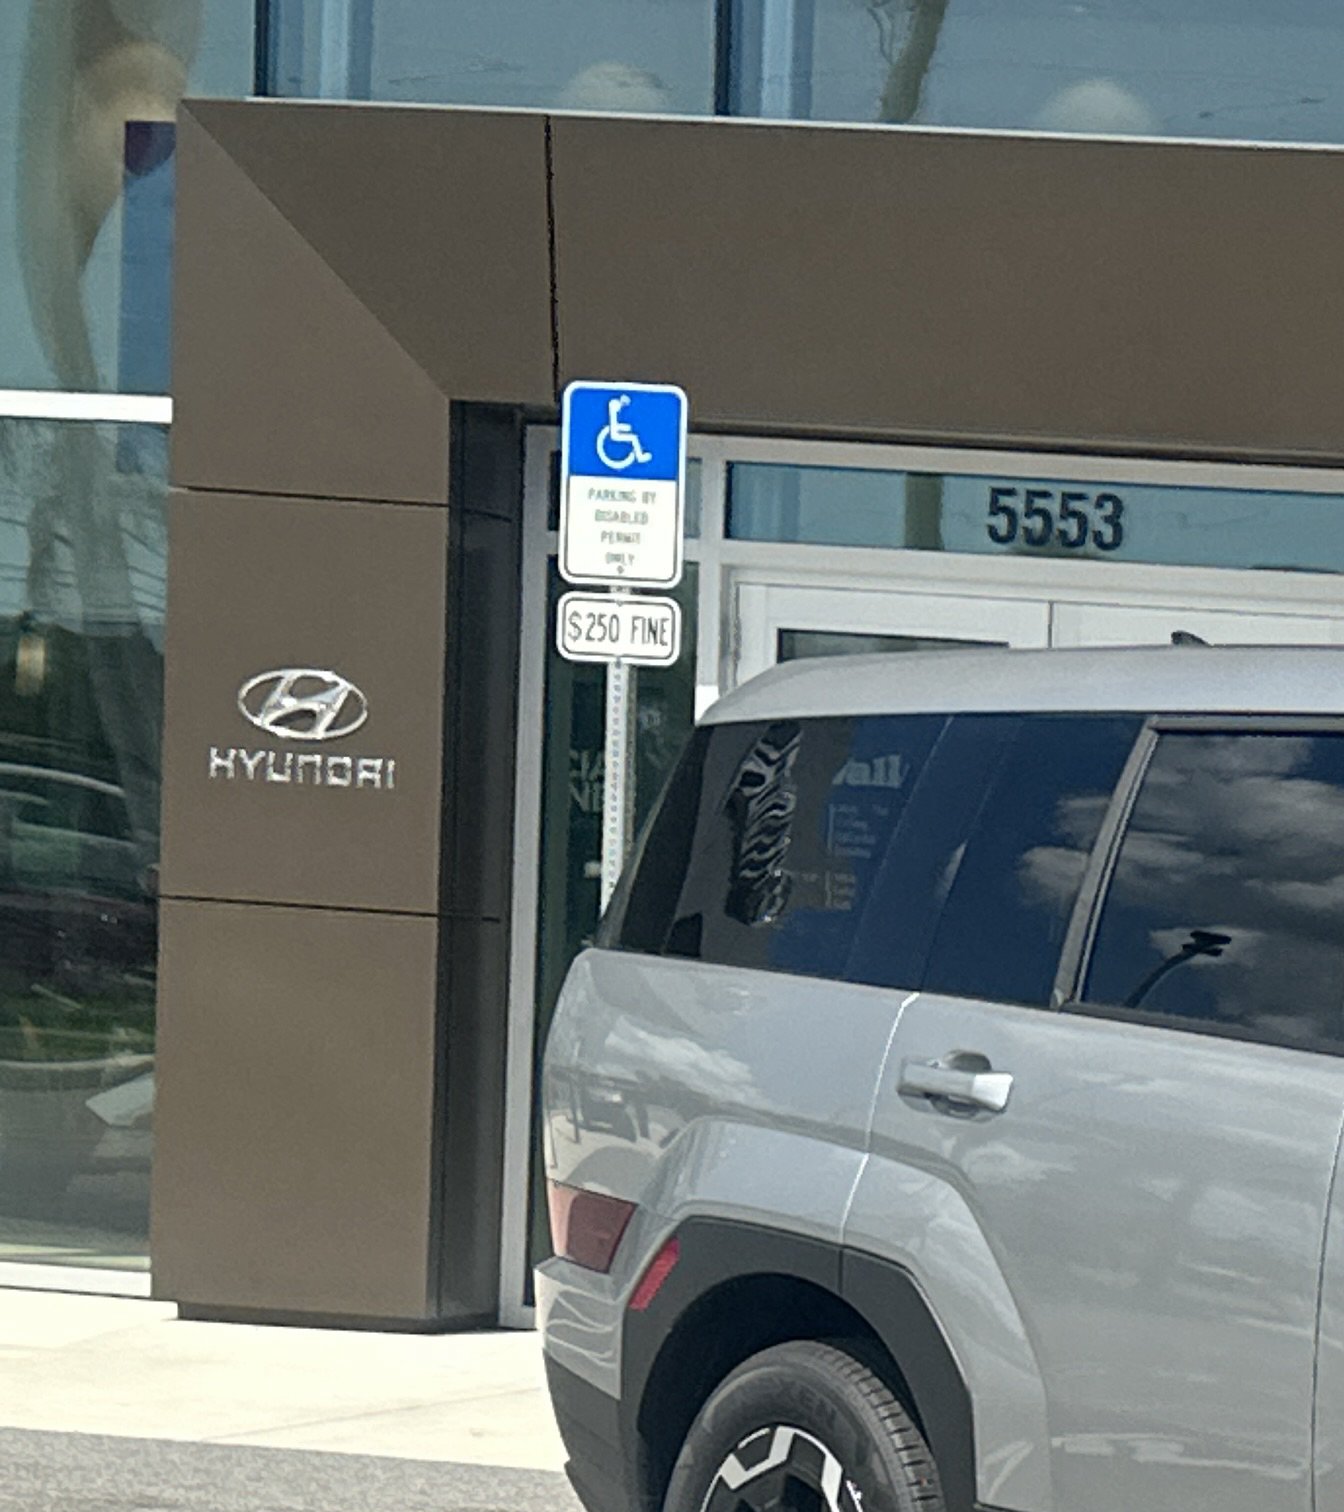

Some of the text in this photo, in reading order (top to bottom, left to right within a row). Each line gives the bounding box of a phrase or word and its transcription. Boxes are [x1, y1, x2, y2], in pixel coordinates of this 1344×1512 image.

[986, 487, 1125, 551] 5553
[568, 611, 669, 647] $250 FINE
[208, 746, 396, 790] HYUNDAI
